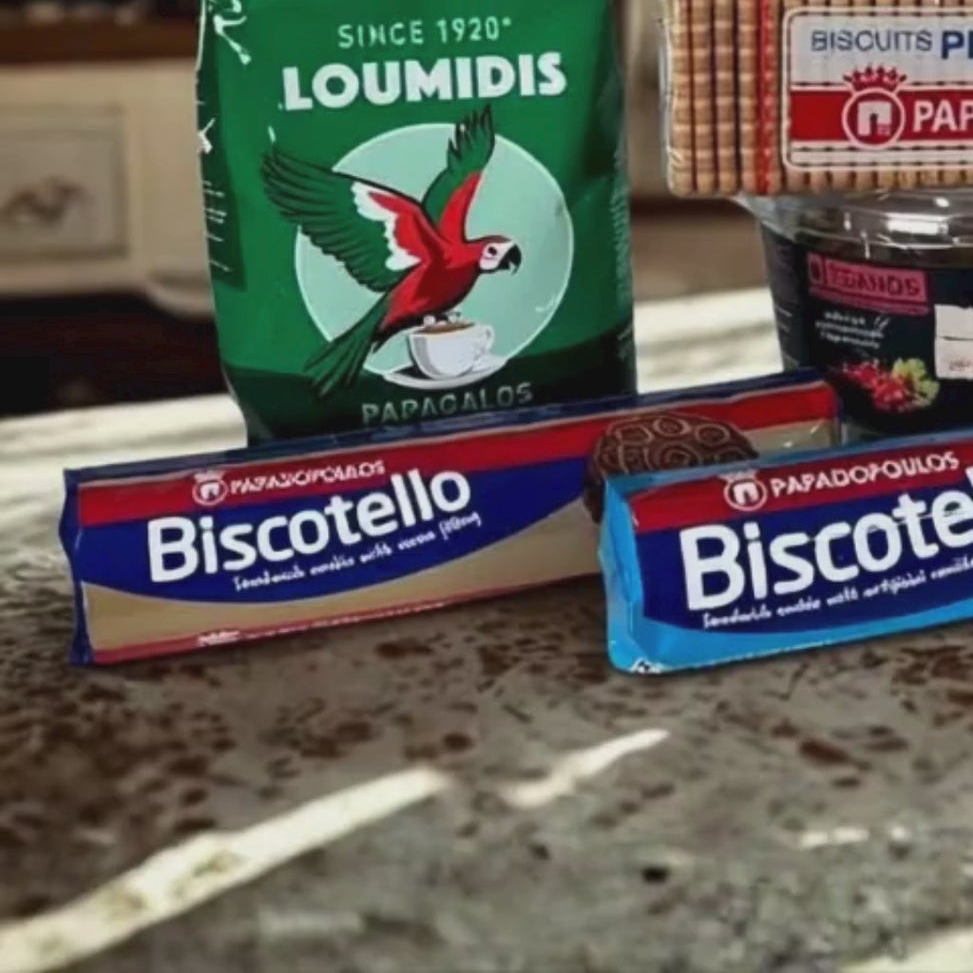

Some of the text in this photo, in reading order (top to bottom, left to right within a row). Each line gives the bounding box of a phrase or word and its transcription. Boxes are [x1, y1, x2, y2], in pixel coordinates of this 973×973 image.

[337, 20, 425, 49] SINCE
[809, 28, 934, 54] BISCUITS
[281, 51, 568, 111] LOUMIDIS
[769, 450, 960, 498] PAPADOPOULOS
[147, 468, 471, 584] Biscotello
